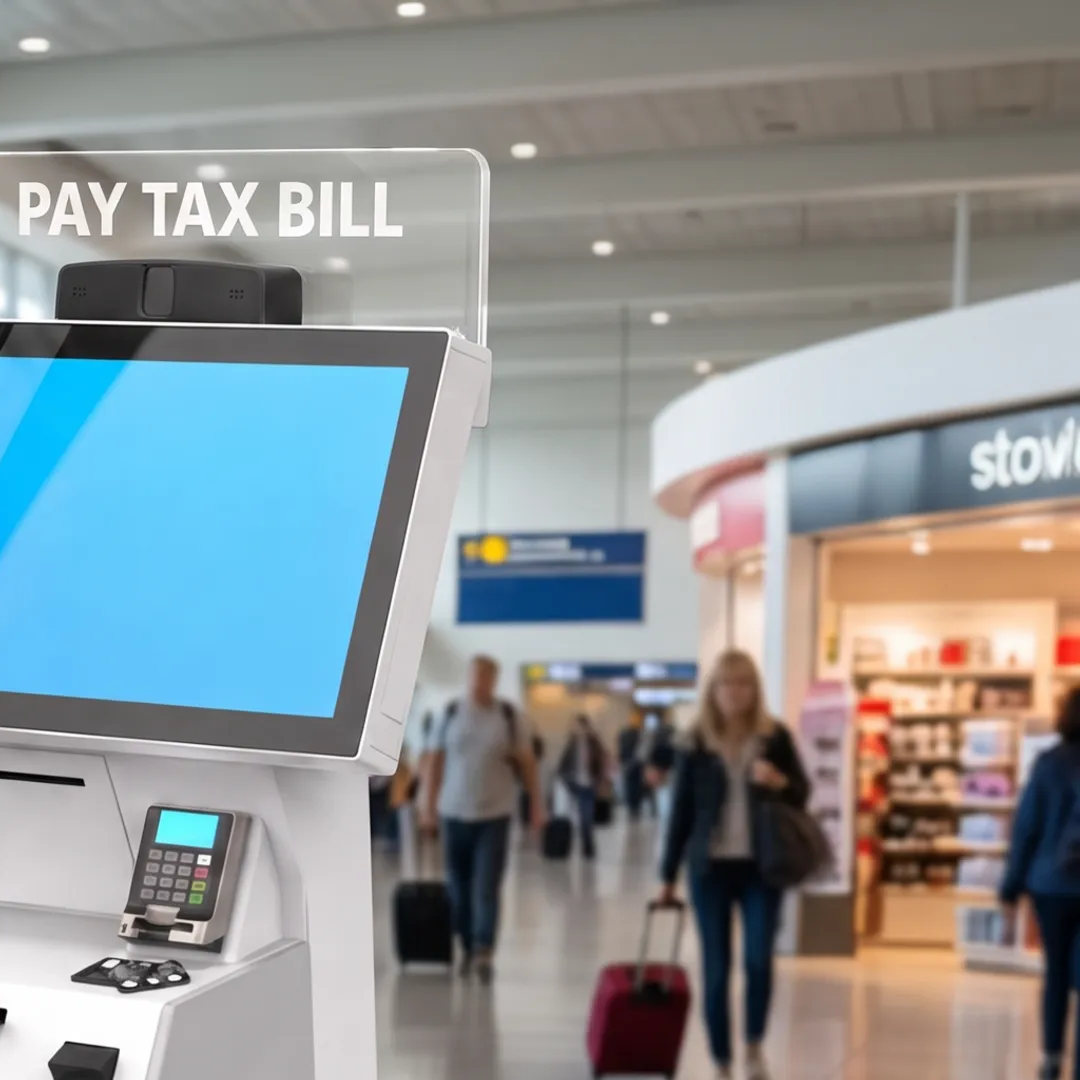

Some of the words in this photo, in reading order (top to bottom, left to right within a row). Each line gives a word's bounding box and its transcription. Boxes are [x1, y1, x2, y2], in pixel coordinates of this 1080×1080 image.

[18, 181, 127, 236] PAY
[142, 181, 259, 237] TAX
[278, 181, 403, 237] BILL
